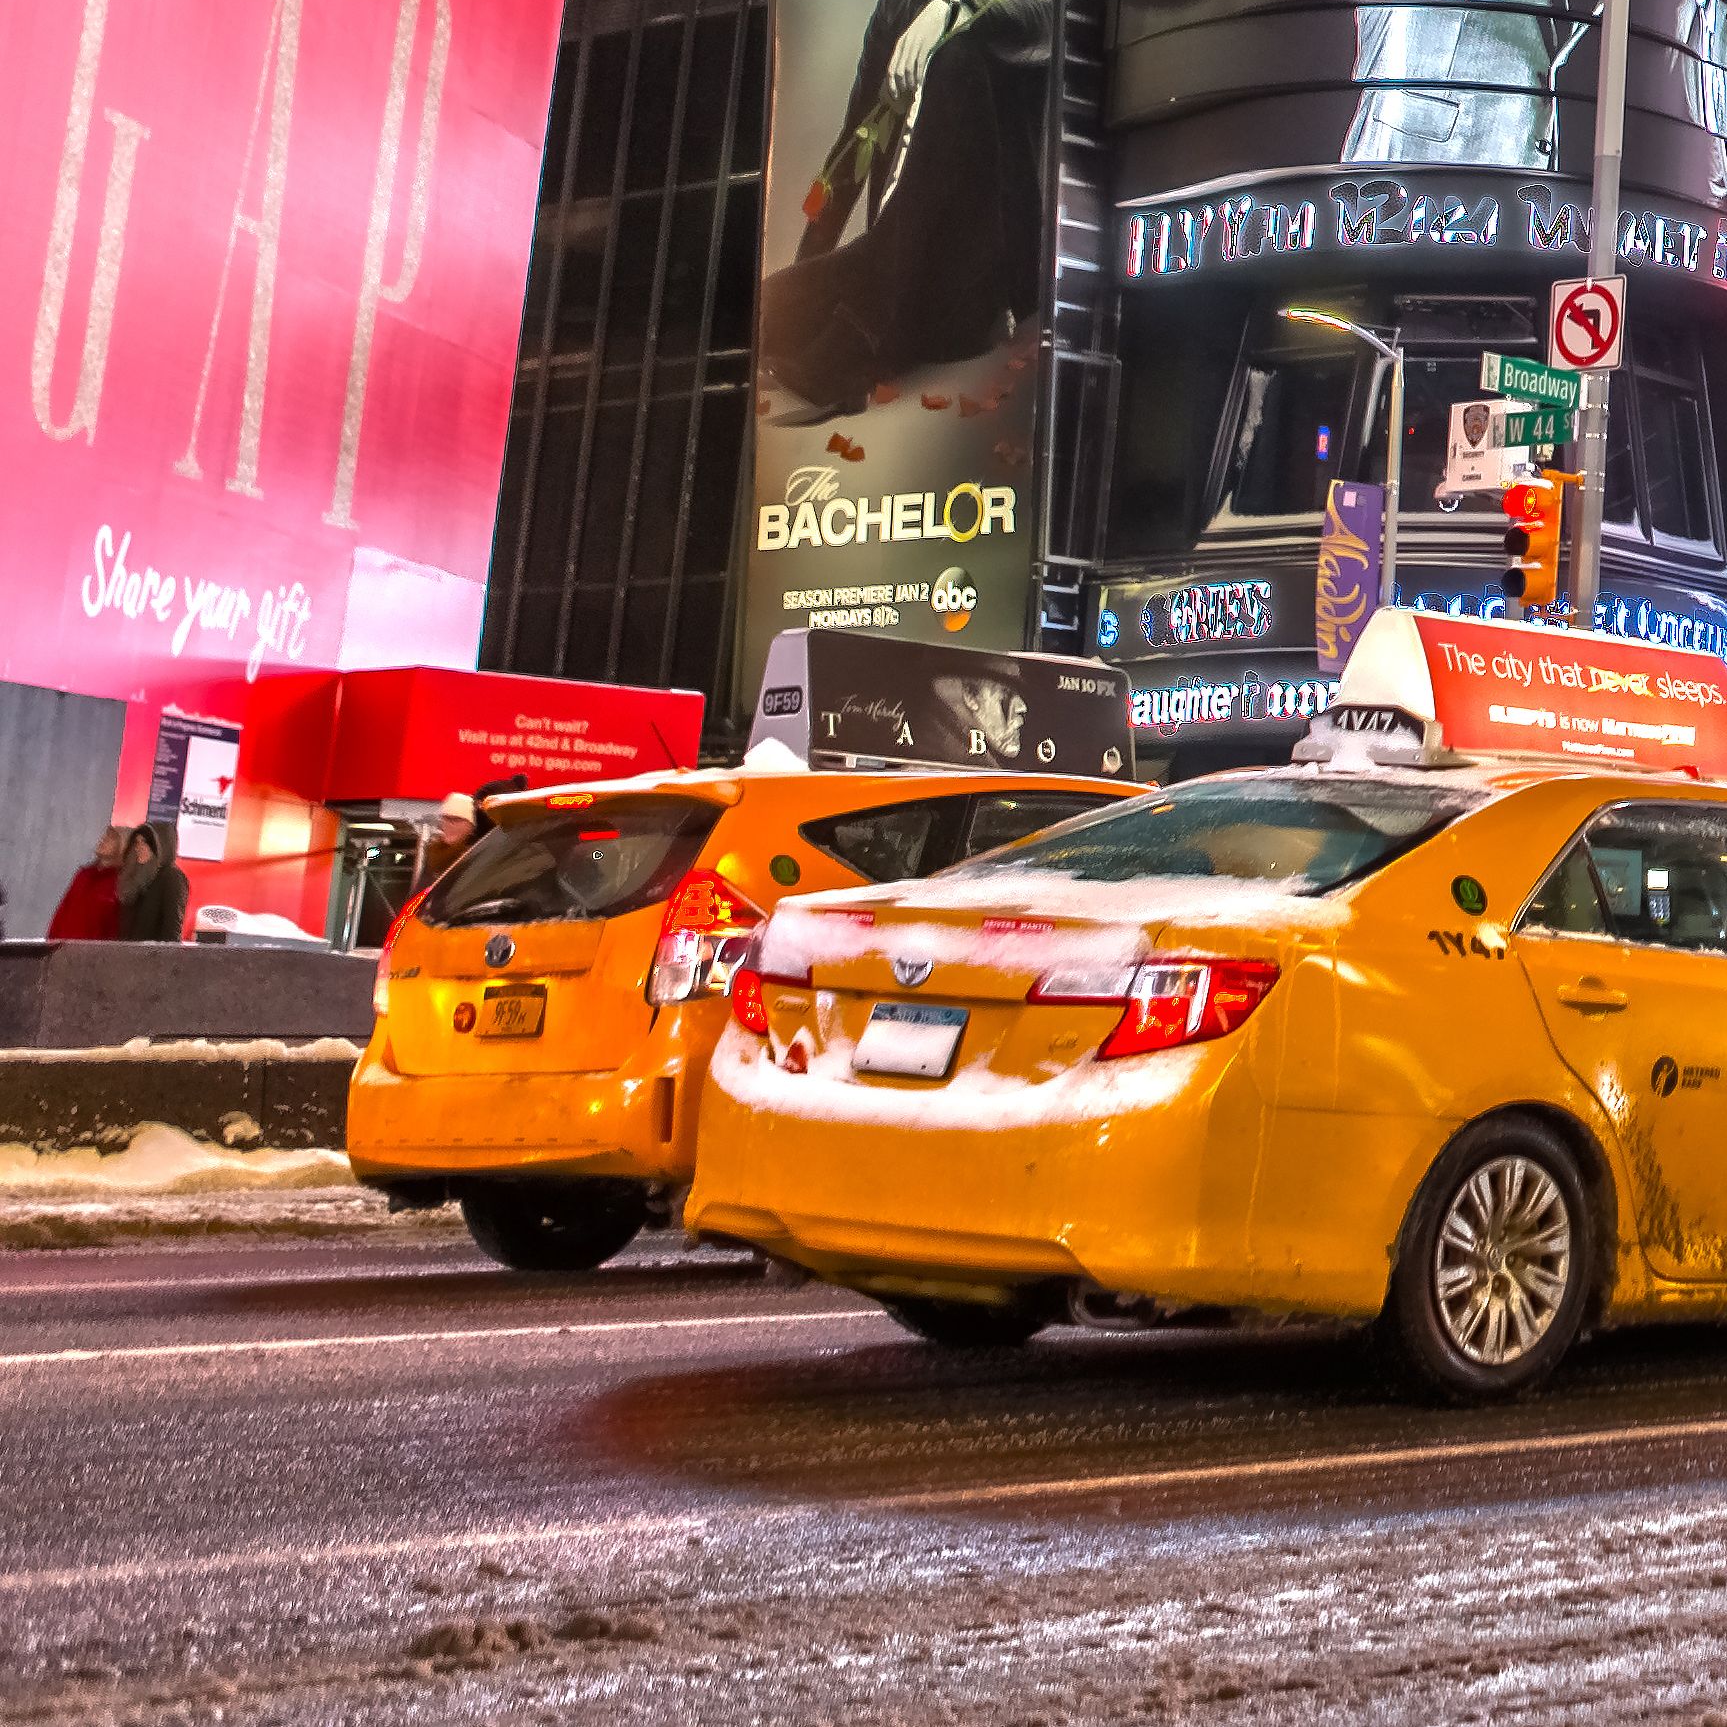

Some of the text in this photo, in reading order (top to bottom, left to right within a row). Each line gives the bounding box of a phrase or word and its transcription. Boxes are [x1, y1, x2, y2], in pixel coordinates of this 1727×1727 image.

[1504, 361, 1578, 408] Broadway
[1509, 414, 1555, 444] W 44
[783, 464, 842, 507] The
[757, 481, 1018, 552] BACHELOR
[80, 524, 313, 684] Share your gift
[782, 581, 931, 610] SEASON PREMIERE JAN 2
[931, 581, 978, 613] abc
[808, 607, 872, 630] MONDAYS
[1057, 674, 1080, 692] JAN
[1437, 642, 1727, 710] The city that never sleeps.
[765, 690, 801, 712] 9F59
[515, 713, 589, 735] Can't wait?
[1558, 714, 1600, 734] is now
[458, 728, 639, 760] Visit us at 42nd & Broadway
[489, 752, 603, 772] or go to gap.com
[983, 919, 1056, 933] DRIVERS WANTED
